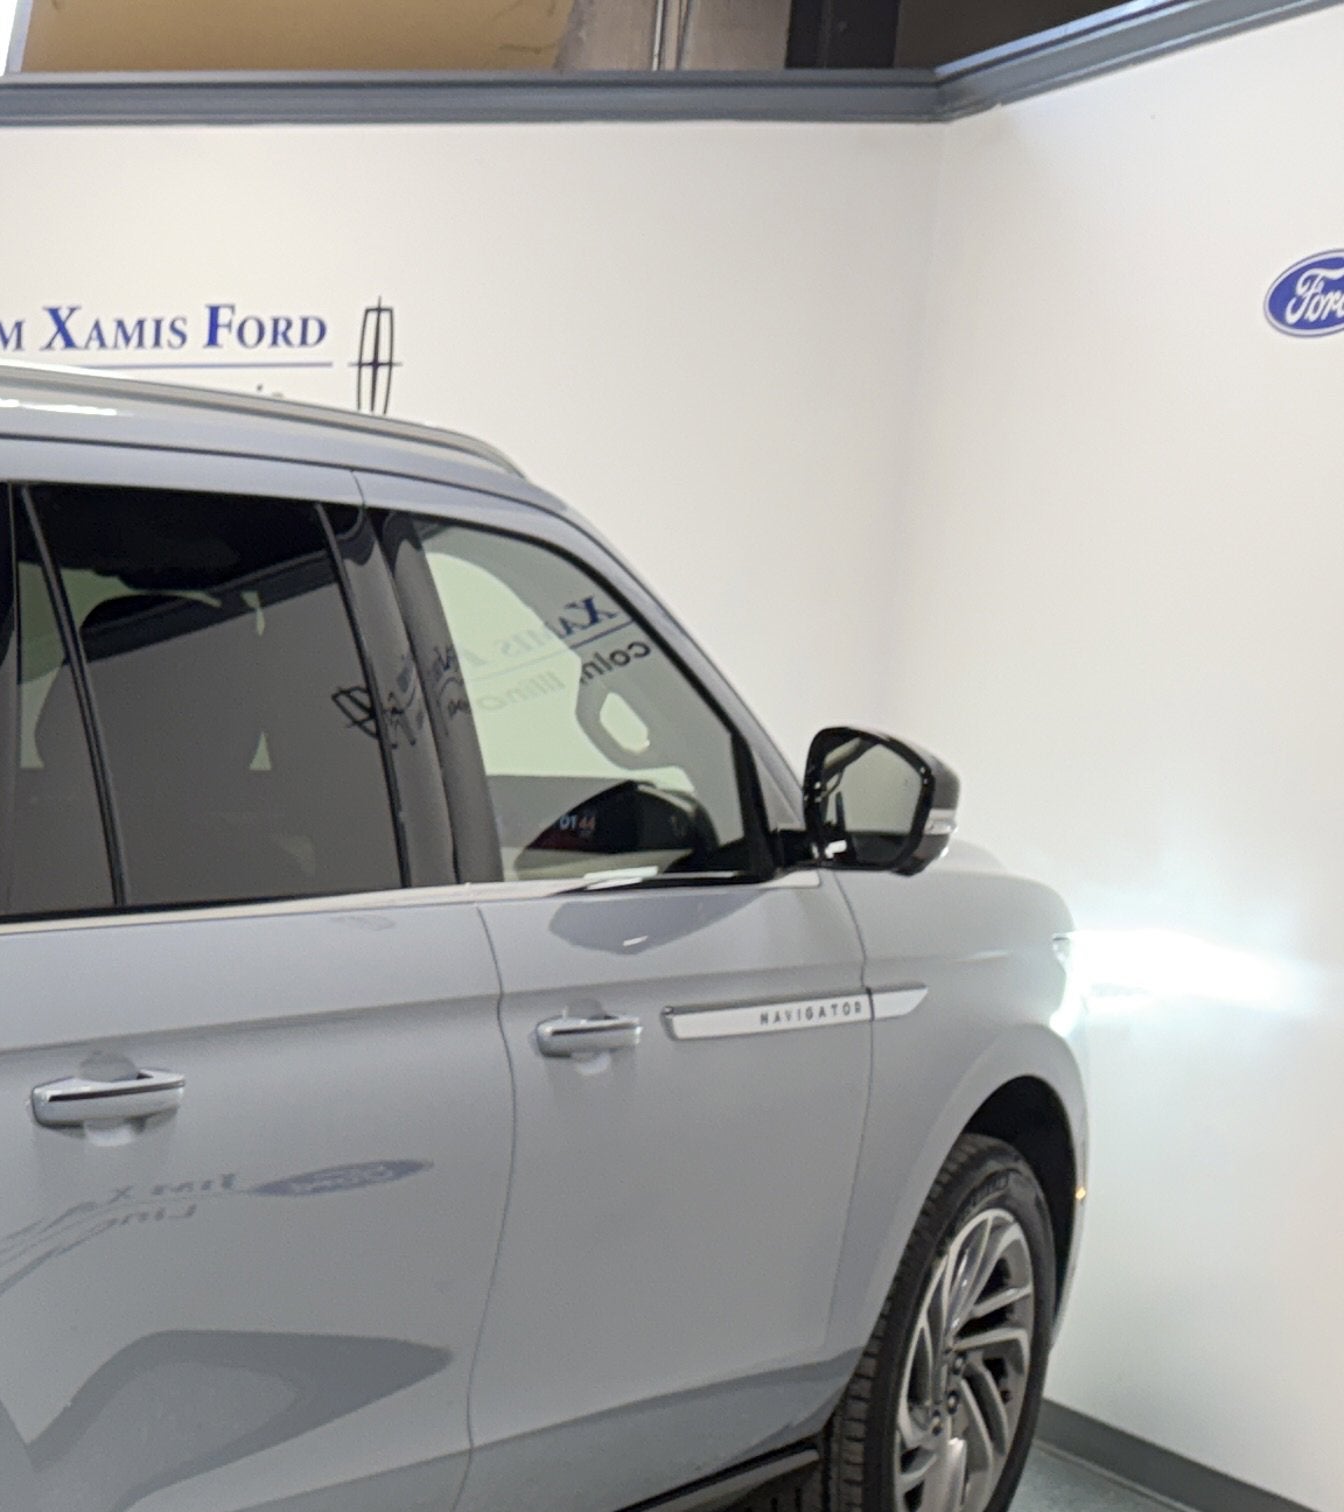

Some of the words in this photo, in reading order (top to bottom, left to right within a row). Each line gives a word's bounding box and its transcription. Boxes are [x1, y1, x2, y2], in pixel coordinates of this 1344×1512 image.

[39, 304, 188, 351] XAMIS
[202, 303, 328, 349] FORD
[760, 1001, 862, 1025] NAVIGATOR
